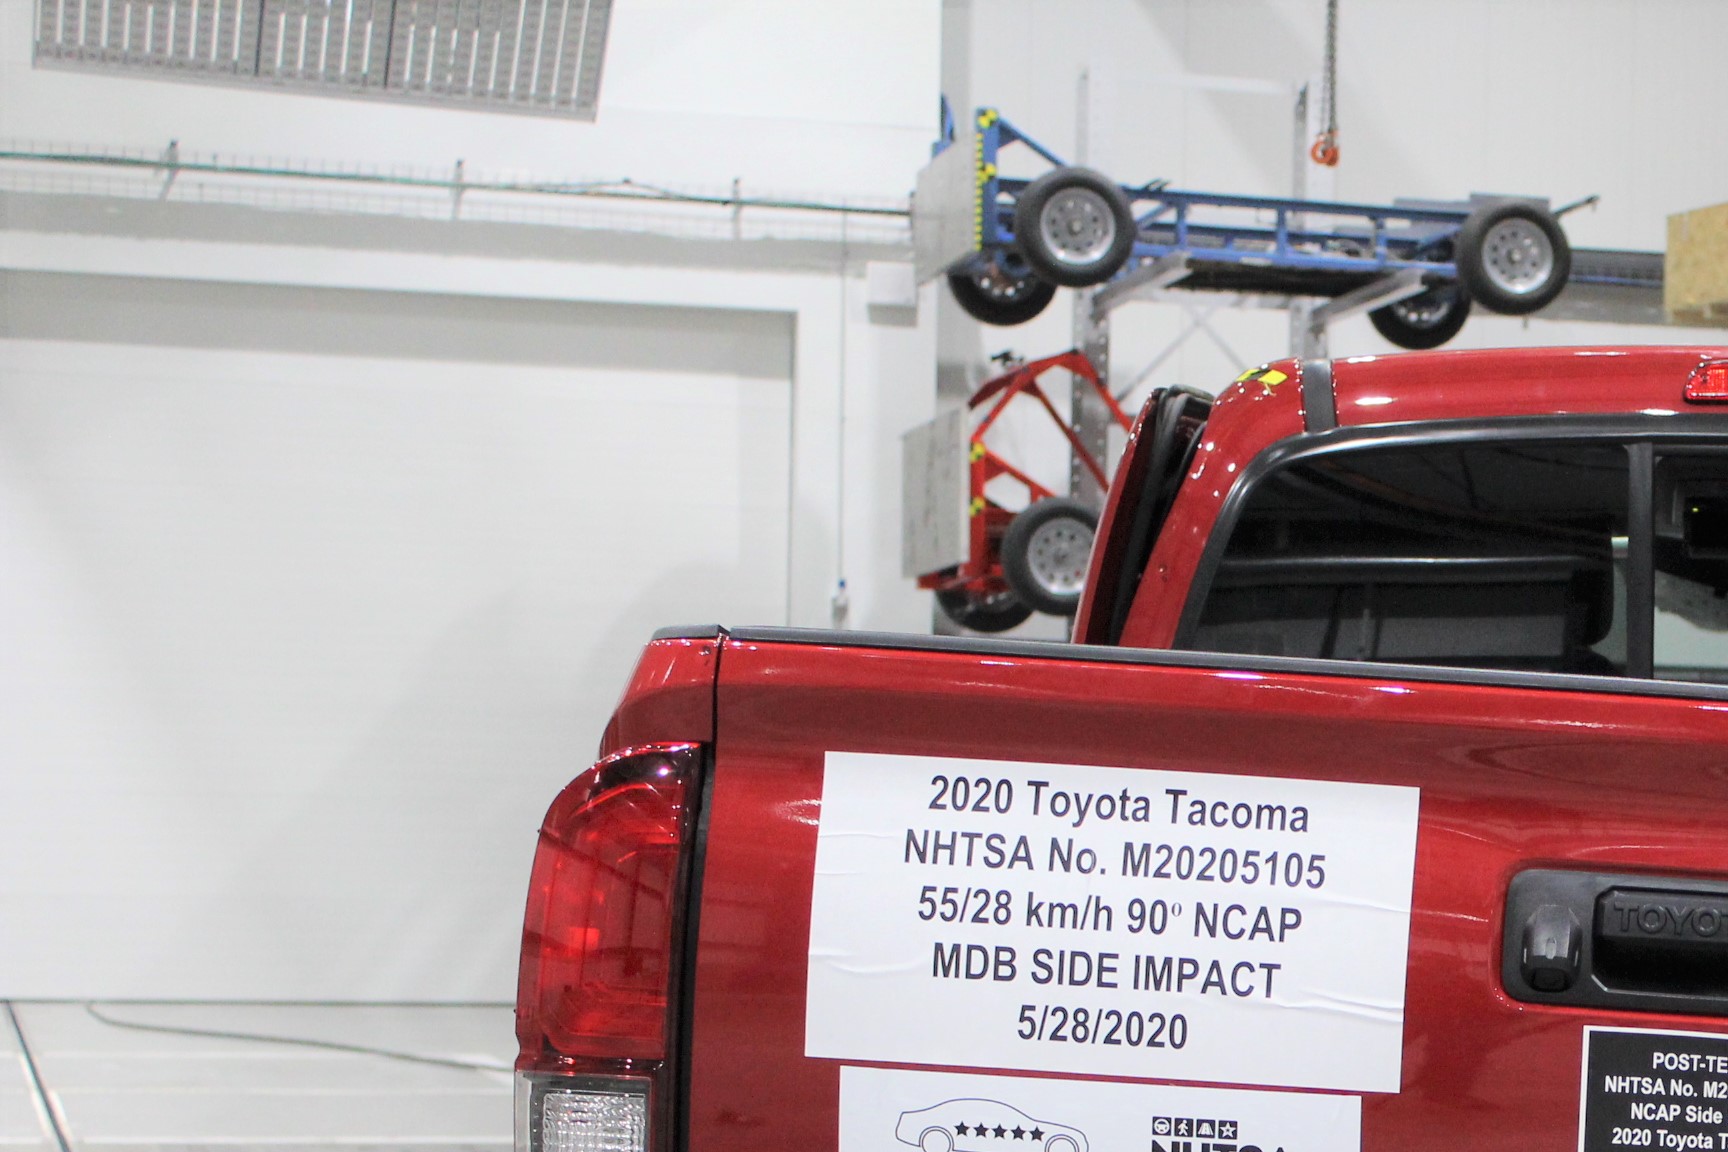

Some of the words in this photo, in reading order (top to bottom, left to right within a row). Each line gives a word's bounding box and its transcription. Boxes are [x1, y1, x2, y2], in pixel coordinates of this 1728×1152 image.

[928, 774, 1013, 814] 2020
[1026, 780, 1150, 828] Toyota
[1165, 788, 1309, 833] Tacoma
[904, 828, 1034, 871] NHTSA
[1048, 837, 1106, 875] No.
[1121, 841, 1326, 889] M20205105
[918, 885, 1012, 926] 55/28
[1025, 891, 1113, 932] km/h
[1194, 902, 1302, 943] NCAP
[932, 942, 1017, 982] MDB
[1031, 948, 1119, 989] SIDE
[1133, 954, 1282, 998] IMPACT
[1017, 1004, 1188, 1050] 5/28/2020
[1604, 1075, 1666, 1096] NHTSA
[1669, 1078, 1698, 1098] No.
[1611, 1126, 1652, 1147] 2020
[1656, 1129, 1714, 1152] Toyota
[1630, 1102, 1682, 1122] NCAP
[1685, 1105, 1723, 1125] Side
